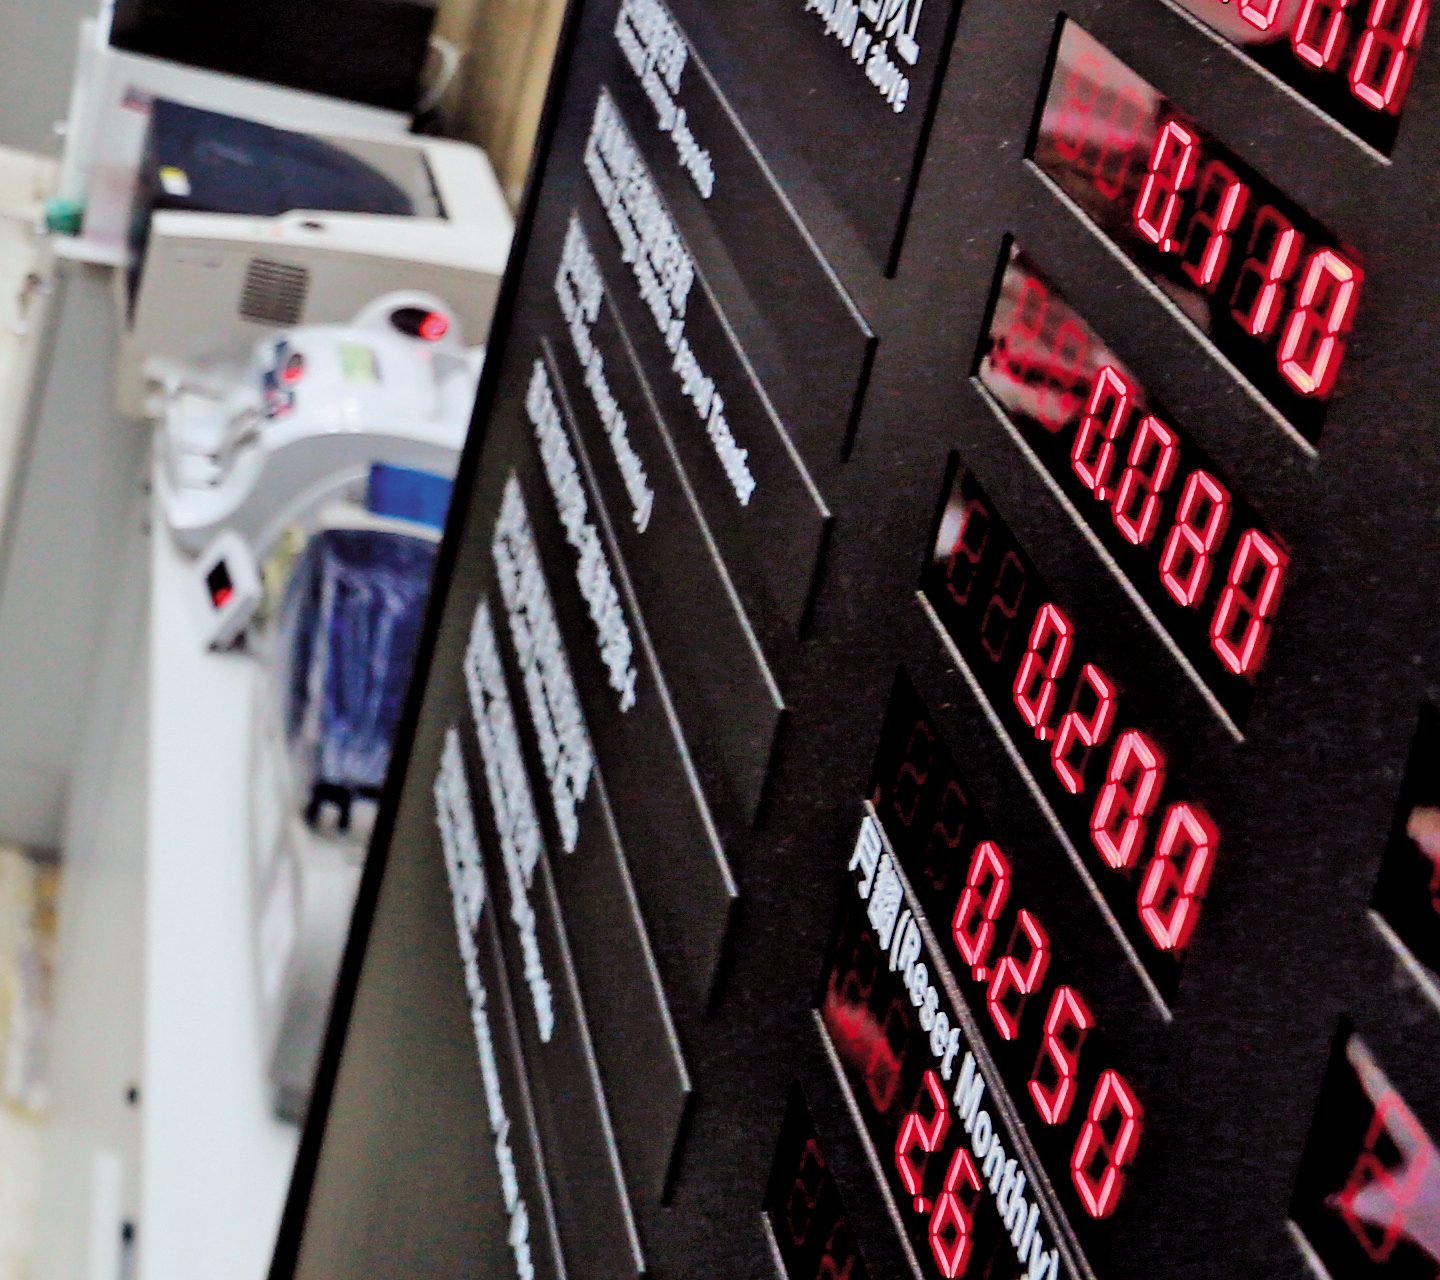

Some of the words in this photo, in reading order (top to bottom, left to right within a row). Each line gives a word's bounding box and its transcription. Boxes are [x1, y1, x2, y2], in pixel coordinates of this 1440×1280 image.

[1135, 118, 1361, 396] 0.110
[1072, 364, 1284, 674] 0.080
[1013, 602, 1212, 951] 0.200
[954, 841, 1139, 1218] 0.250
